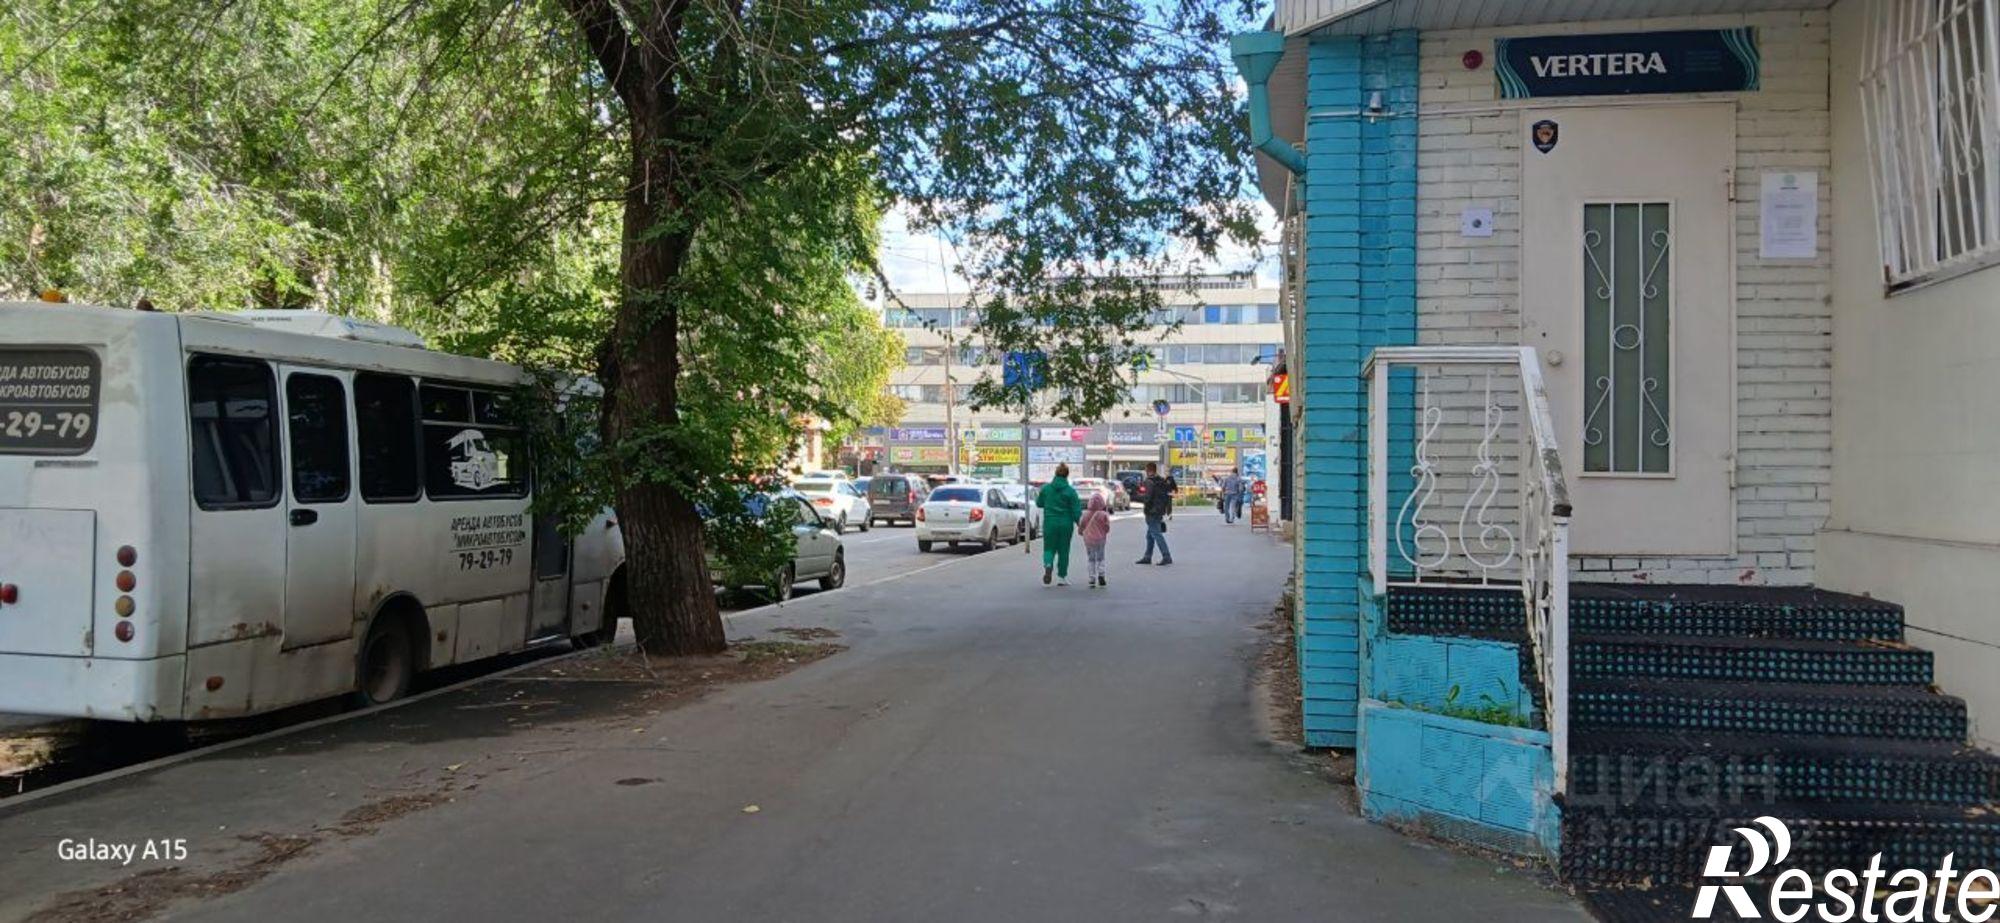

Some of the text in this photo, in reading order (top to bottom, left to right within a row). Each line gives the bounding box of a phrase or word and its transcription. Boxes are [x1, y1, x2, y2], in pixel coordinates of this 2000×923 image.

[1530, 52, 1667, 77] VERTERA
[0, 366, 91, 381] ДА АВТОБУСОВ
[450, 513, 523, 531] АРЕНДА АВТОБУСОВ
[458, 547, 513, 571] 79-29-79
